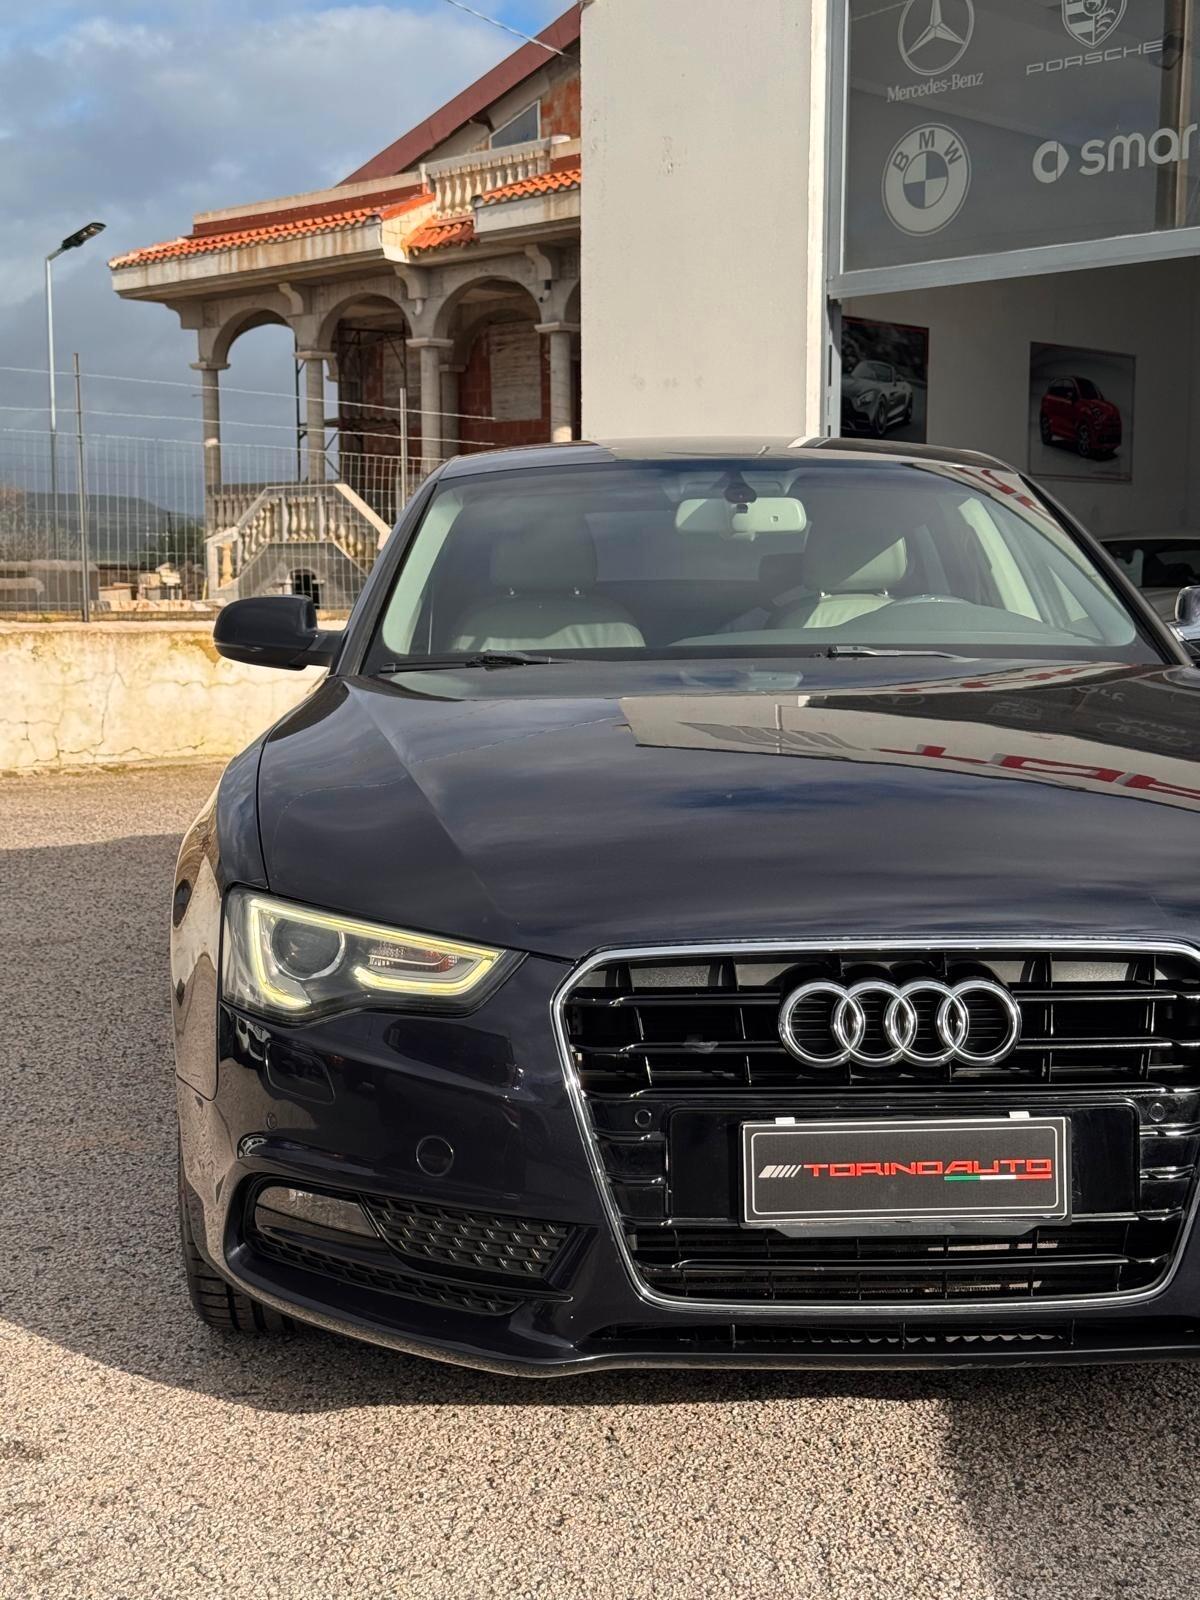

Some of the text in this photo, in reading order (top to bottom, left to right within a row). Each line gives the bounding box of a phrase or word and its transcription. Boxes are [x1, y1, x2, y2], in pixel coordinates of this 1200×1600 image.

[1026, 39, 1163, 76] PORSCHE
[886, 72, 984, 103] Mercedes-Benz
[892, 129, 963, 173] BMW
